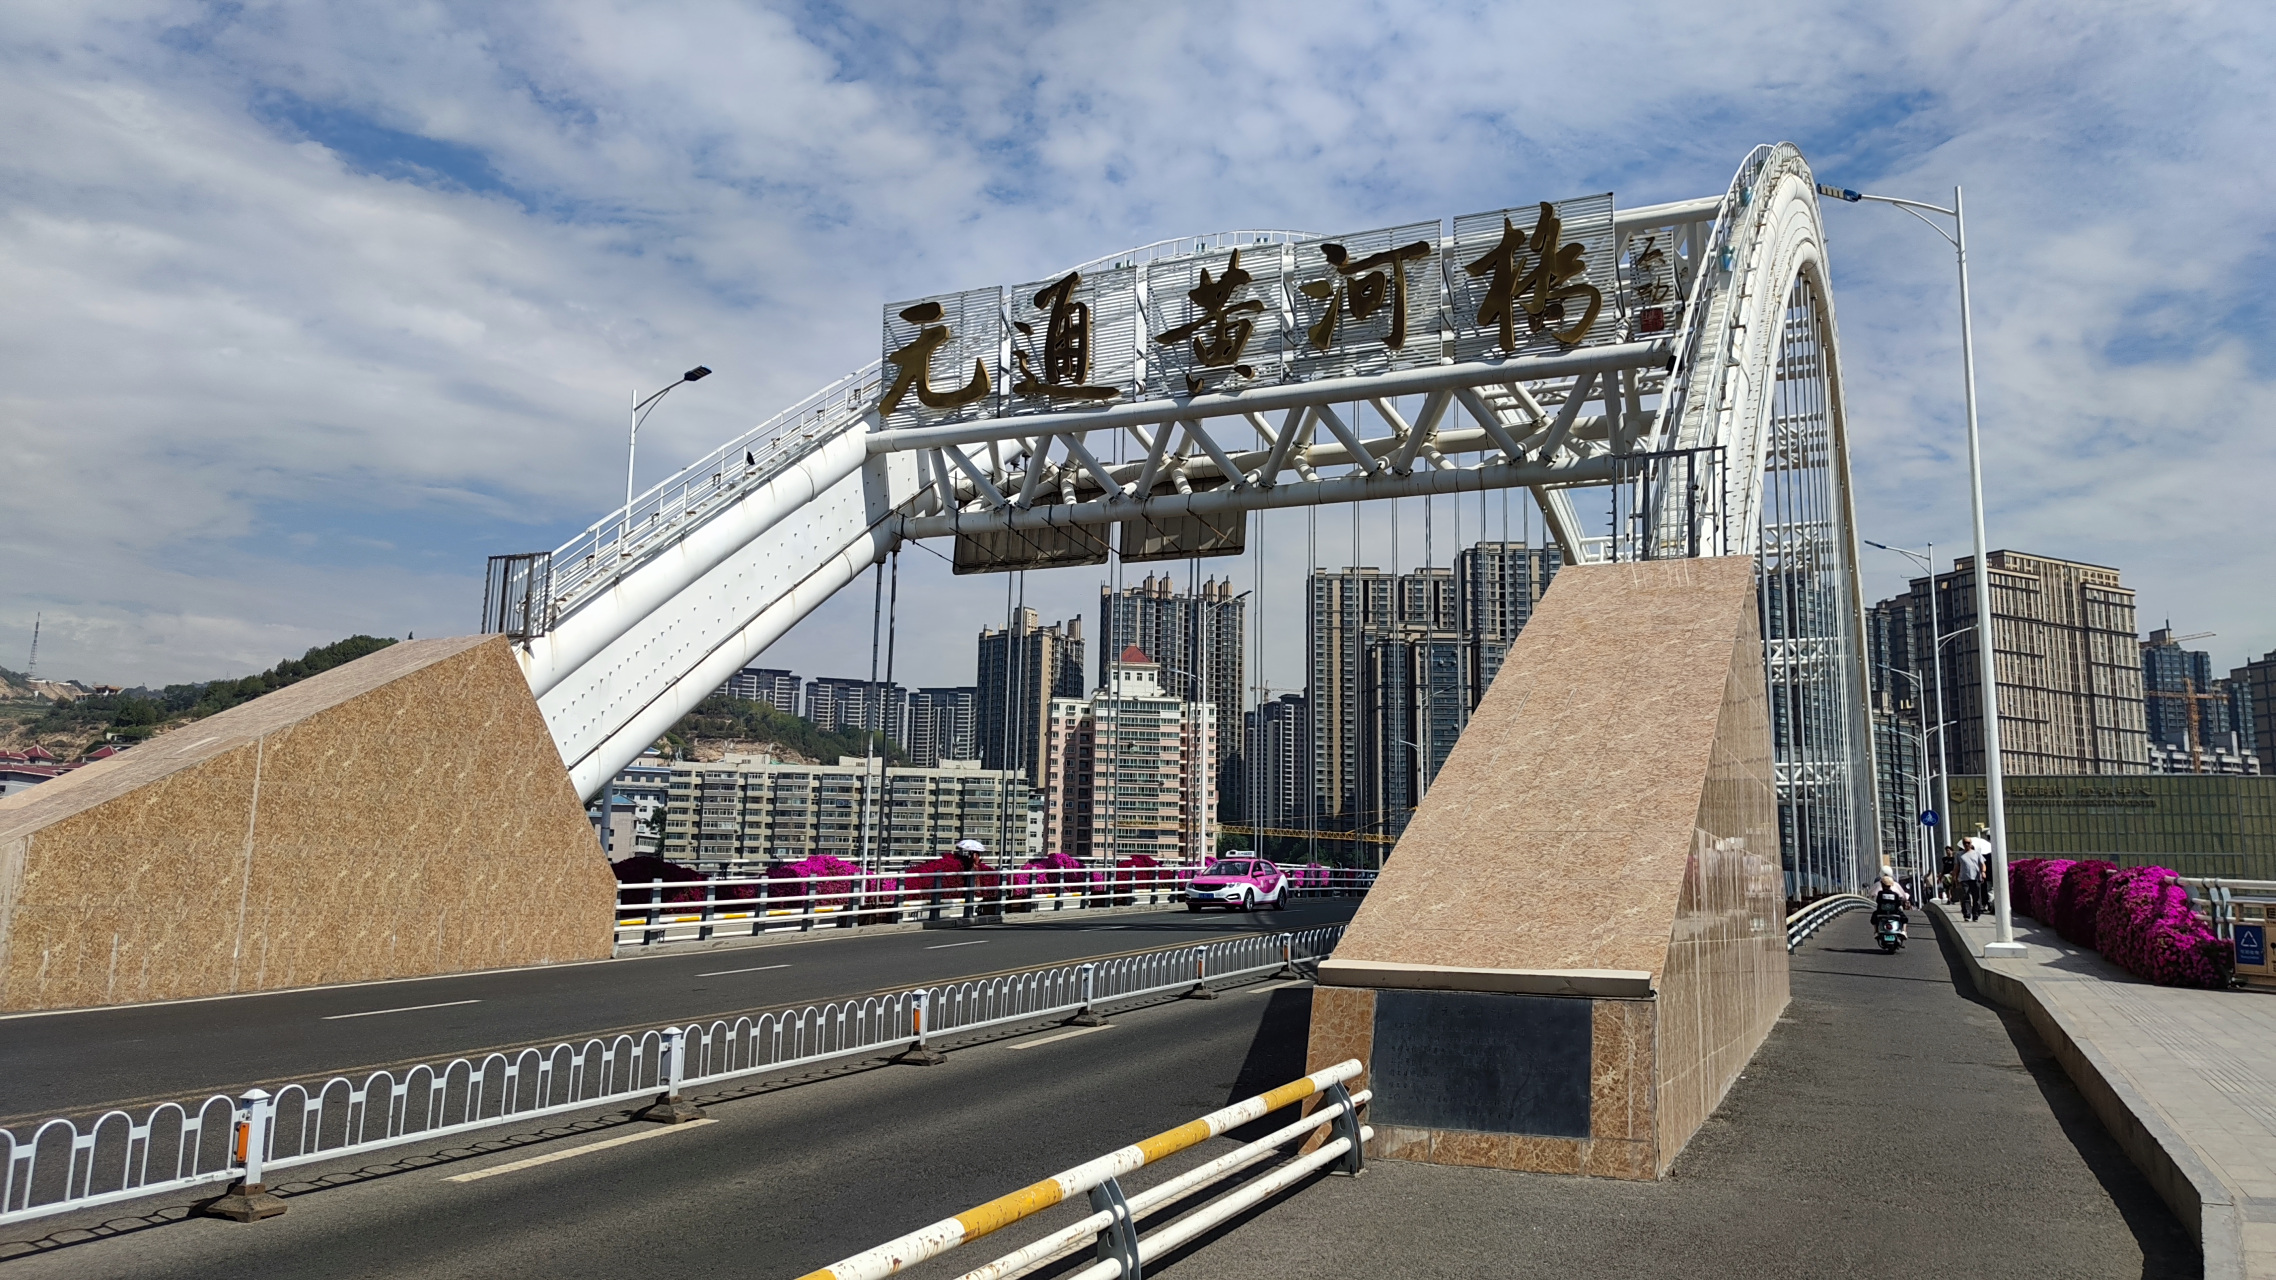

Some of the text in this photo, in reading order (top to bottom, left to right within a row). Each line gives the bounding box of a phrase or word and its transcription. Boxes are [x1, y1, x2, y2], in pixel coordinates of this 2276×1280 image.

[879, 201, 1603, 416] 元通黄河桥
